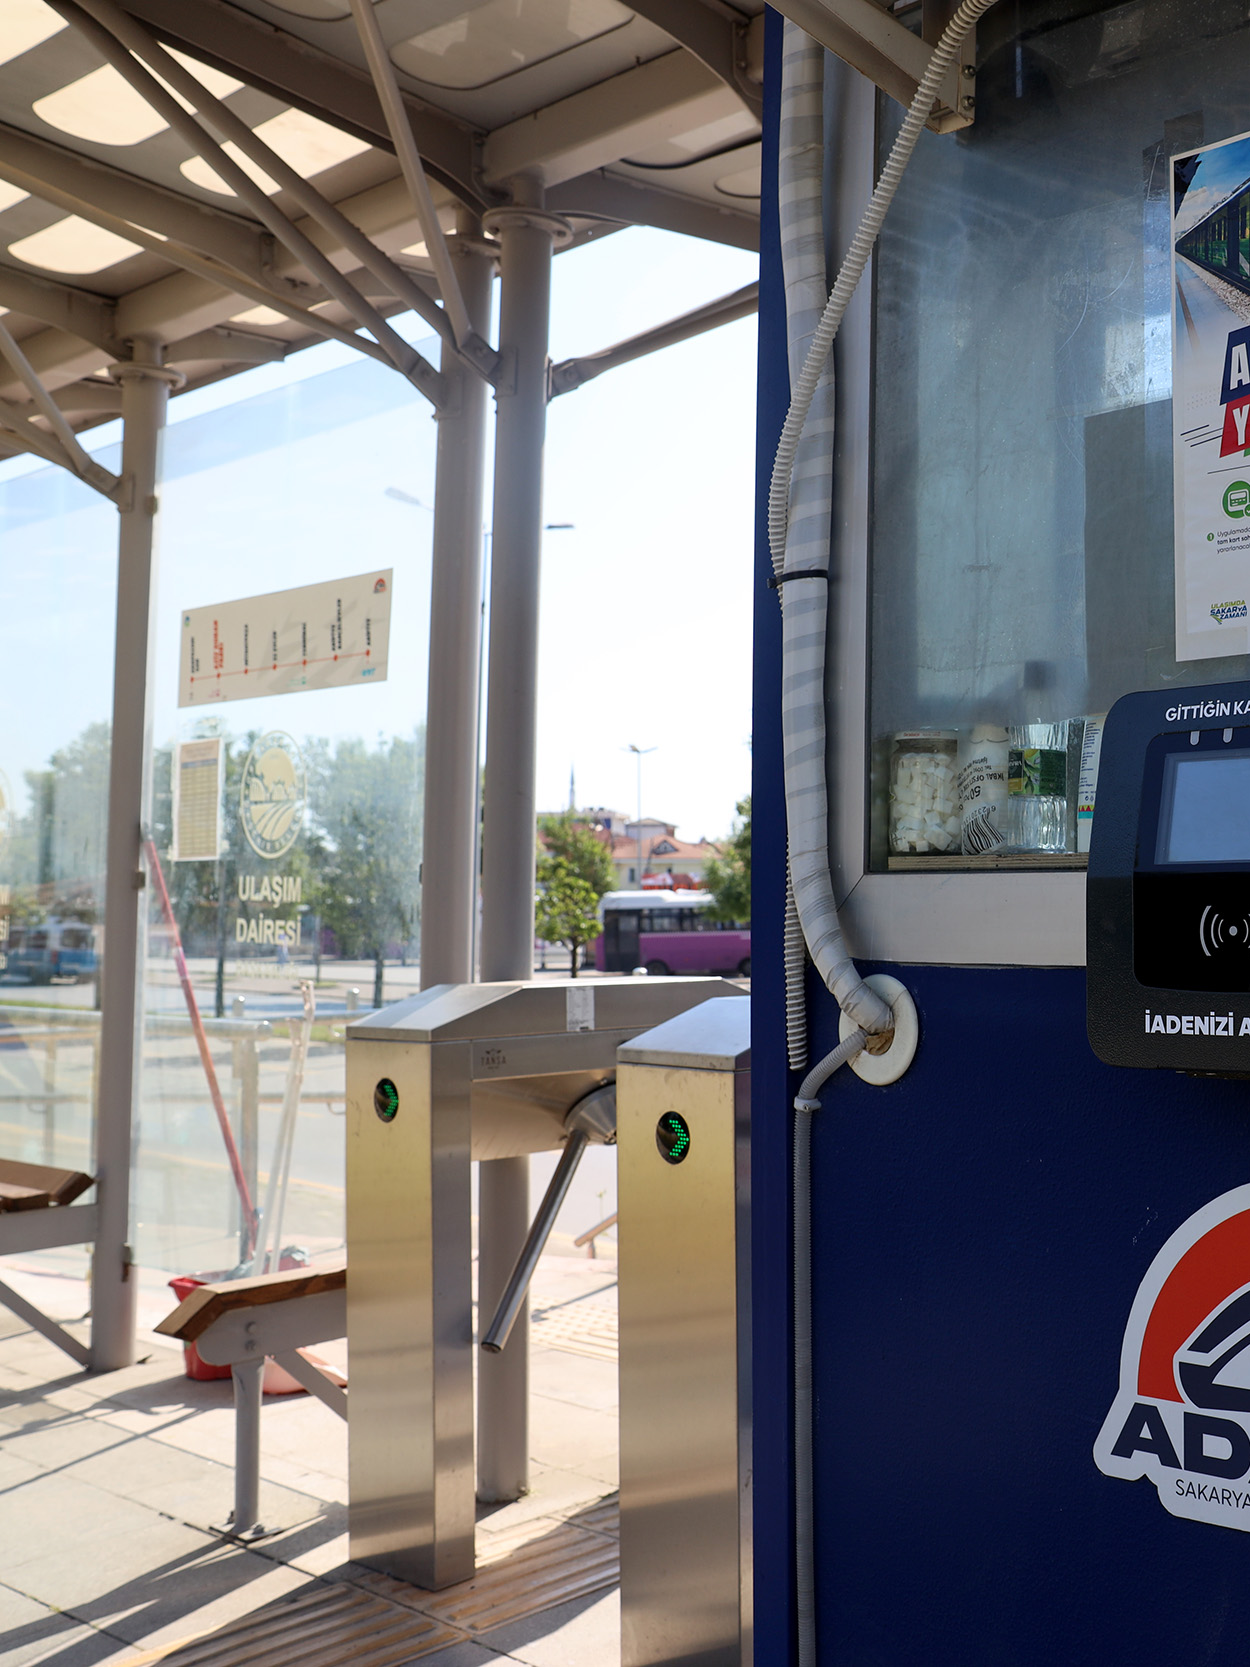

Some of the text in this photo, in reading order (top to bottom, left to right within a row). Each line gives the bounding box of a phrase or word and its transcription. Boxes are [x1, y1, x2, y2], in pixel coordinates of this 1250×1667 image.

[1220, 611, 1248, 619] ZAMANI
[1165, 700, 1230, 722] GİTTİĞİN
[238, 875, 302, 908] ULAŞIM
[235, 913, 302, 946] DAİRESİ
[1145, 1009, 1234, 1036] İADENİZİ
